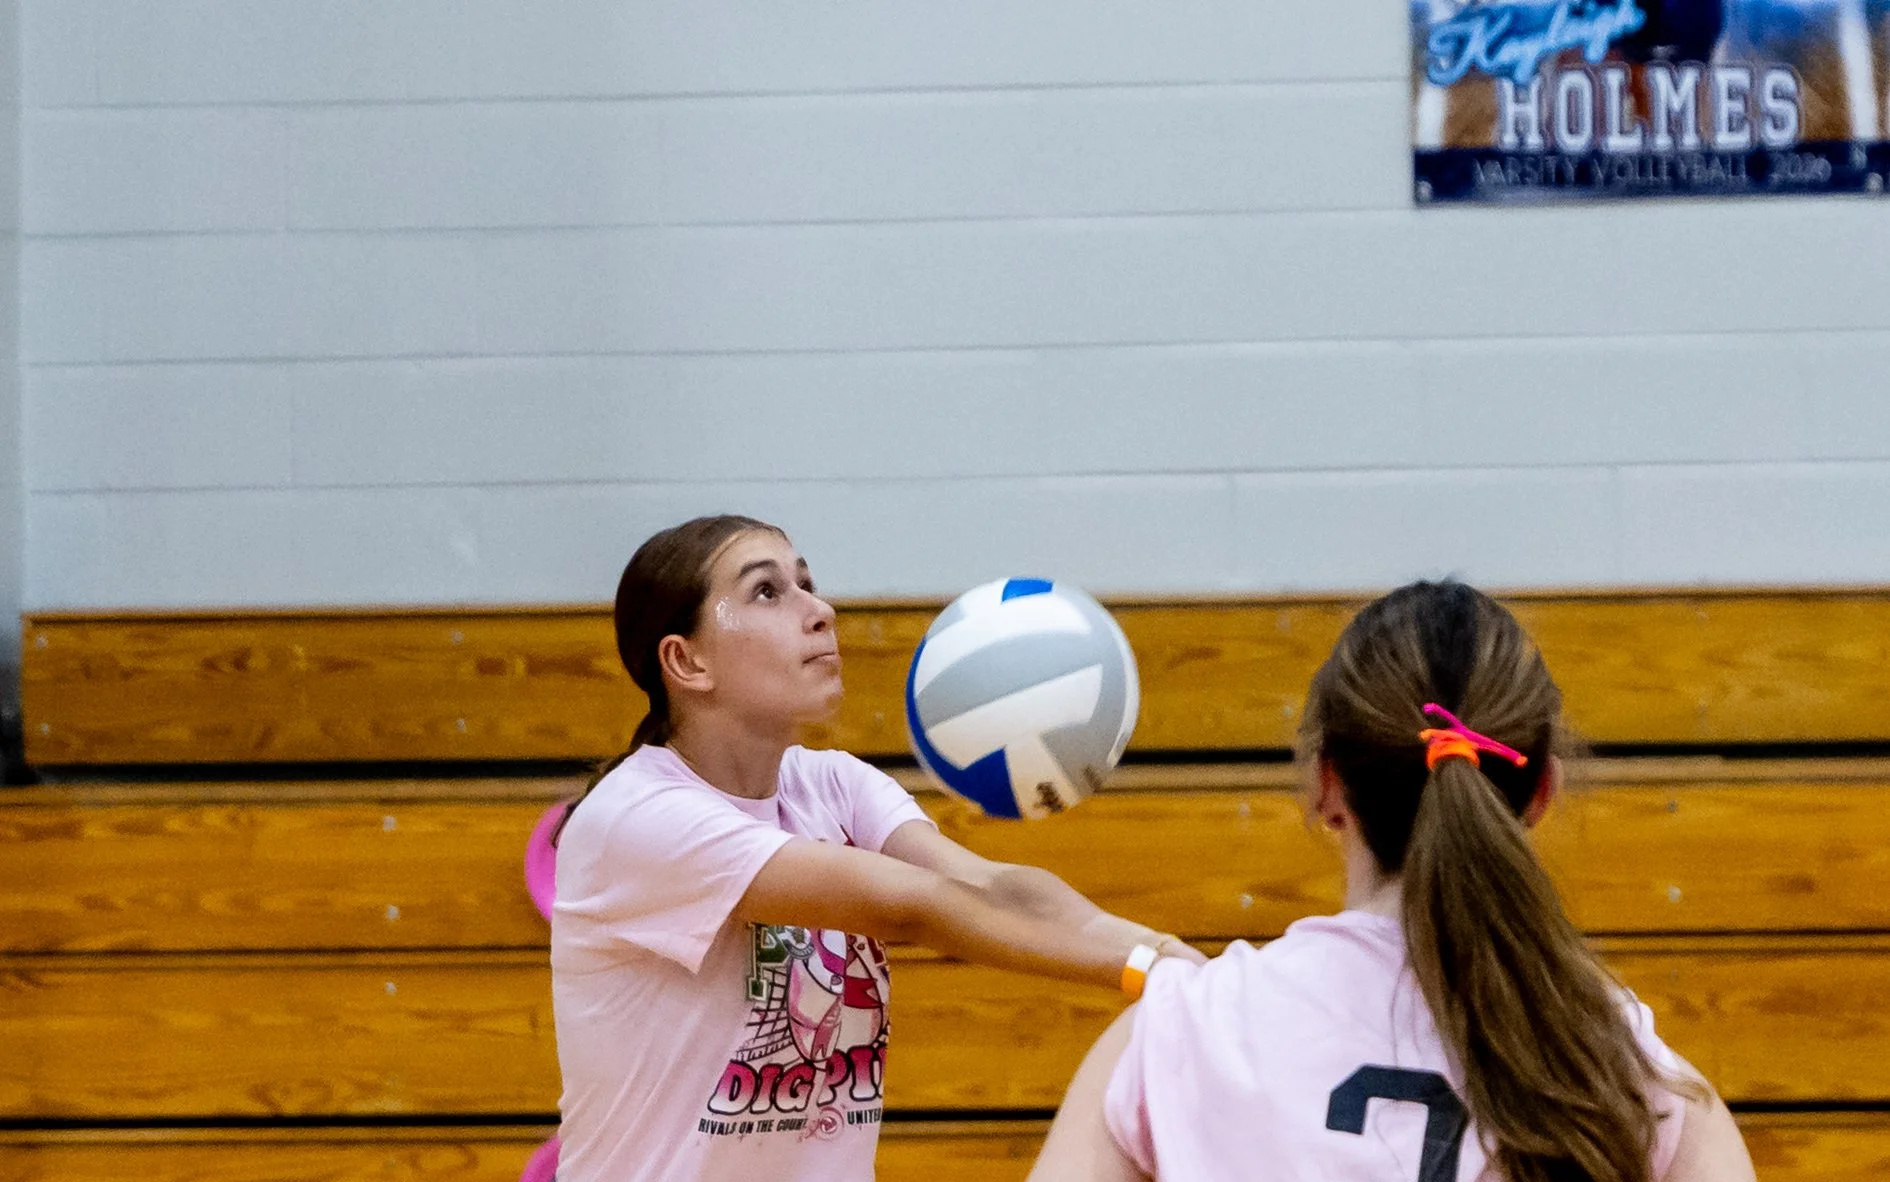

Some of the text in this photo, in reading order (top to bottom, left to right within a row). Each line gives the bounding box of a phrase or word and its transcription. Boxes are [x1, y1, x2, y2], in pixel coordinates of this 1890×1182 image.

[1499, 64, 1800, 151] HOLMES
[1474, 154, 1578, 186] VARSITY
[1595, 152, 1748, 185] VOLLEYBALL
[707, 1046, 884, 1115] DIG PI
[698, 1118, 738, 1136] RIVALS
[738, 1120, 755, 1135] ON
[755, 1119, 775, 1133] THE
